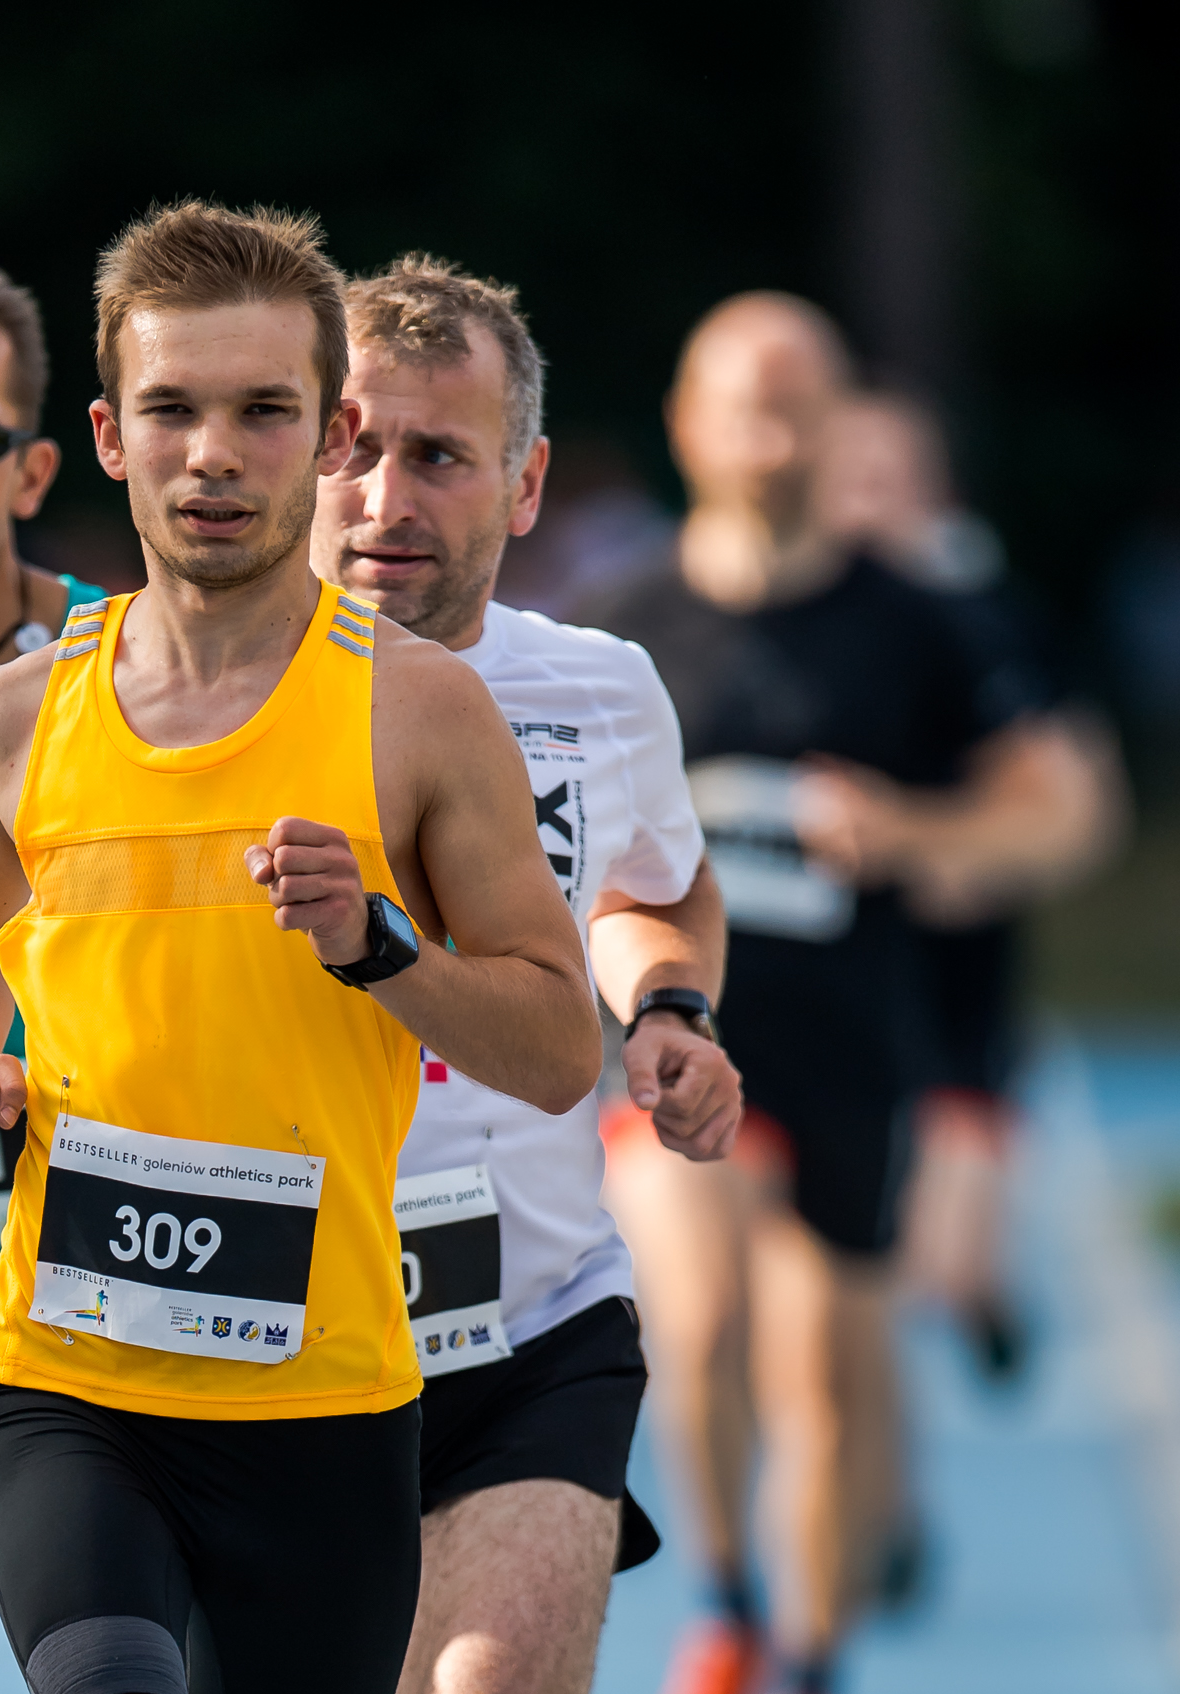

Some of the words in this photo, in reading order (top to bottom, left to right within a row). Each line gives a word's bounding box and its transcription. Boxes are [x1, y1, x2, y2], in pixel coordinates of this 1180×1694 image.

[59, 1138, 139, 1166] BESTSELLER
[143, 1156, 206, 1176] goleniów
[209, 1164, 273, 1184] athletics
[277, 1174, 314, 1190] park
[394, 1191, 451, 1214] athletics
[455, 1185, 486, 1205] park
[109, 1204, 222, 1274] 309
[52, 1266, 111, 1287] BESTSELLER
